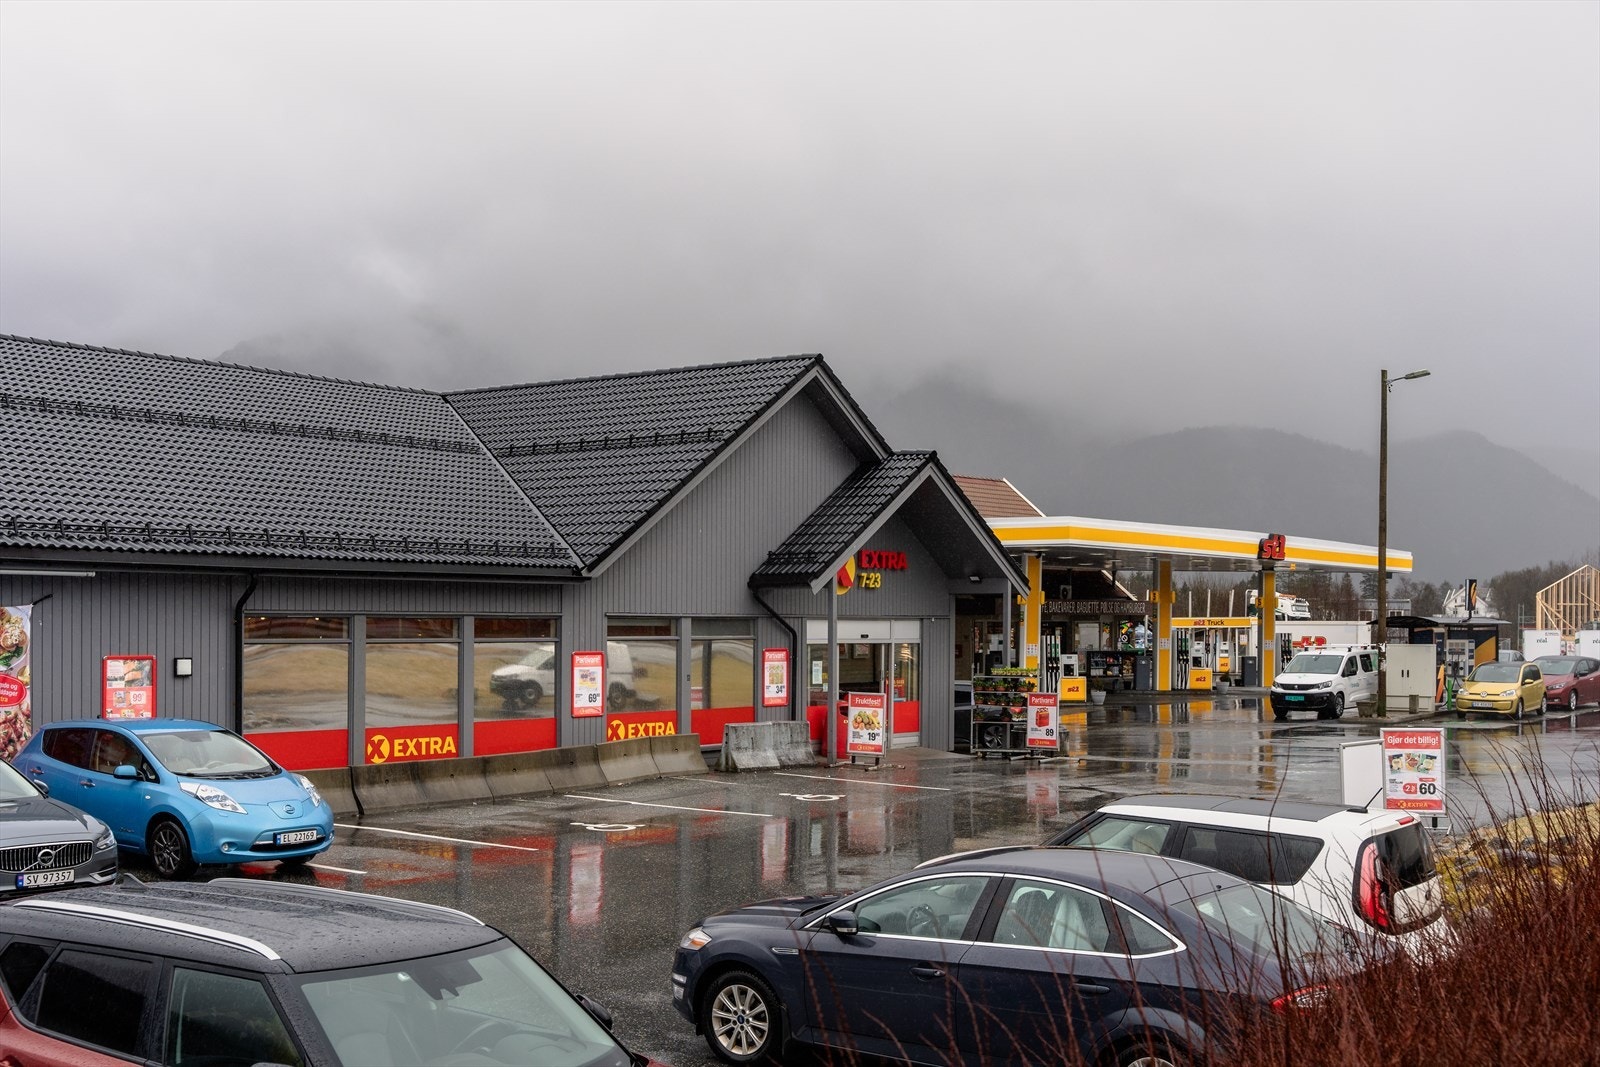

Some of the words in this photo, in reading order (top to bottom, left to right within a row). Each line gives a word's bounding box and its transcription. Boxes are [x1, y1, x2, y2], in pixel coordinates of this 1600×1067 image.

[1259, 533, 1286, 560] st1
[860, 549, 908, 570] EXTRA
[860, 572, 881, 588] 7-23
[855, 697, 881, 706] Fruktfest!
[627, 721, 676, 740] EXTRA
[1045, 728, 1054, 737] 89
[393, 736, 457, 757] EXTRA
[1387, 736, 1403, 745] Gjør
[1404, 736, 1417, 744] det
[1417, 736, 1439, 746] billig!
[1419, 783, 1436, 795] 60
[283, 834, 291, 843] EL
[293, 831, 315, 841] 22169
[26, 875, 39, 885] SV
[43, 871, 72, 883] 97357
